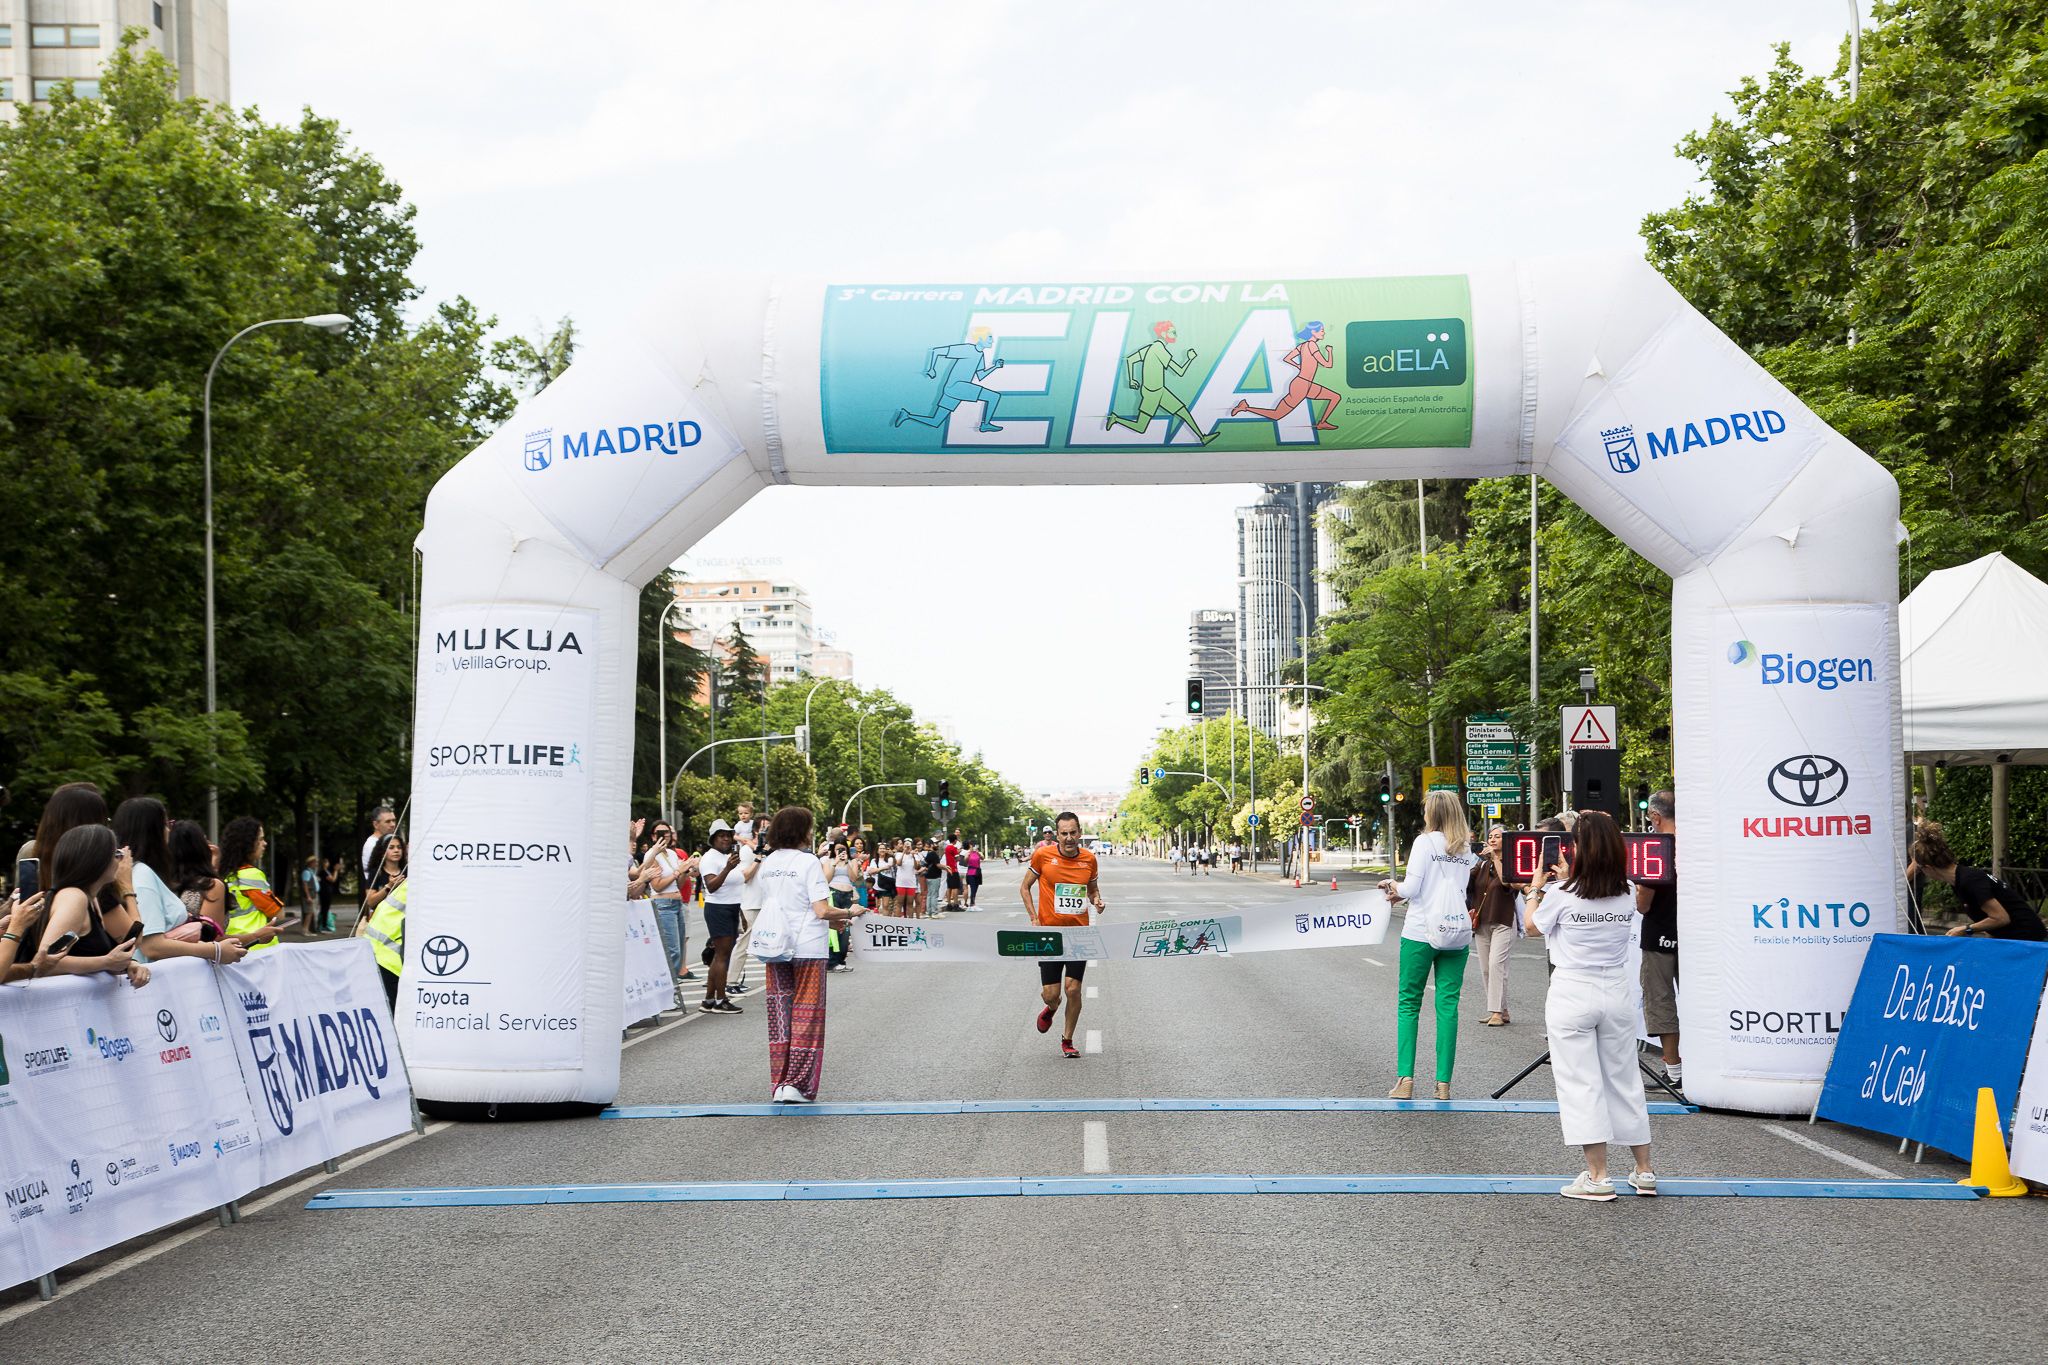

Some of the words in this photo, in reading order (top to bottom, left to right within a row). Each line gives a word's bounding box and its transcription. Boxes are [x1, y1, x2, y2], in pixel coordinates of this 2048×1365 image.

[870, 288, 965, 301] Carrera
[974, 286, 1135, 305] MADRID
[1145, 284, 1232, 303] CON
[1239, 283, 1290, 302] LA
[1363, 348, 1450, 373] adELA
[943, 306, 1320, 448] ELA
[1346, 396, 1391, 404] Asociación
[1393, 395, 1431, 404] Española
[1432, 394, 1444, 402] de
[1345, 408, 1387, 416] Esclerosis
[1389, 407, 1417, 415] Lateral
[1418, 405, 1467, 414] Amiotrófica
[563, 420, 702, 460] MADRID
[1646, 410, 1786, 460] MADRID
[436, 628, 583, 655] MUKUA
[435, 660, 448, 675] by
[452, 655, 551, 674] VelillaGroup.
[528, 769, 563, 778] EVENTOS
[1059, 897, 1083, 908] 1319
[865, 923, 913, 935] SPORT
[1139, 922, 1178, 931] MADRID
[1180, 920, 1201, 928] CON
[1313, 913, 1372, 929] MADRID
[873, 935, 908, 947] LIFE
[1007, 942, 1054, 952] adELA
[1133, 923, 1228, 958] ELA
[1754, 935, 1790, 945] Flexible
[1792, 935, 1831, 946] Mobility
[1833, 934, 1872, 944] Solutions
[417, 988, 470, 1009] Toyota
[1883, 964, 1916, 1021] De
[1912, 964, 1935, 1022] la
[1932, 965, 1986, 1031] Base
[415, 1012, 491, 1031] Financial
[499, 1013, 578, 1031] Services
[98, 1036, 135, 1061] Biogen
[1731, 1035, 1774, 1046] MOVILIDAD,
[278, 1008, 388, 1102] MADRID
[1861, 1044, 1888, 1099] al
[1881, 1045, 1927, 1107] Cielo
[177, 1141, 201, 1162] MADRID
[4, 1180, 50, 1209] MUKUA
